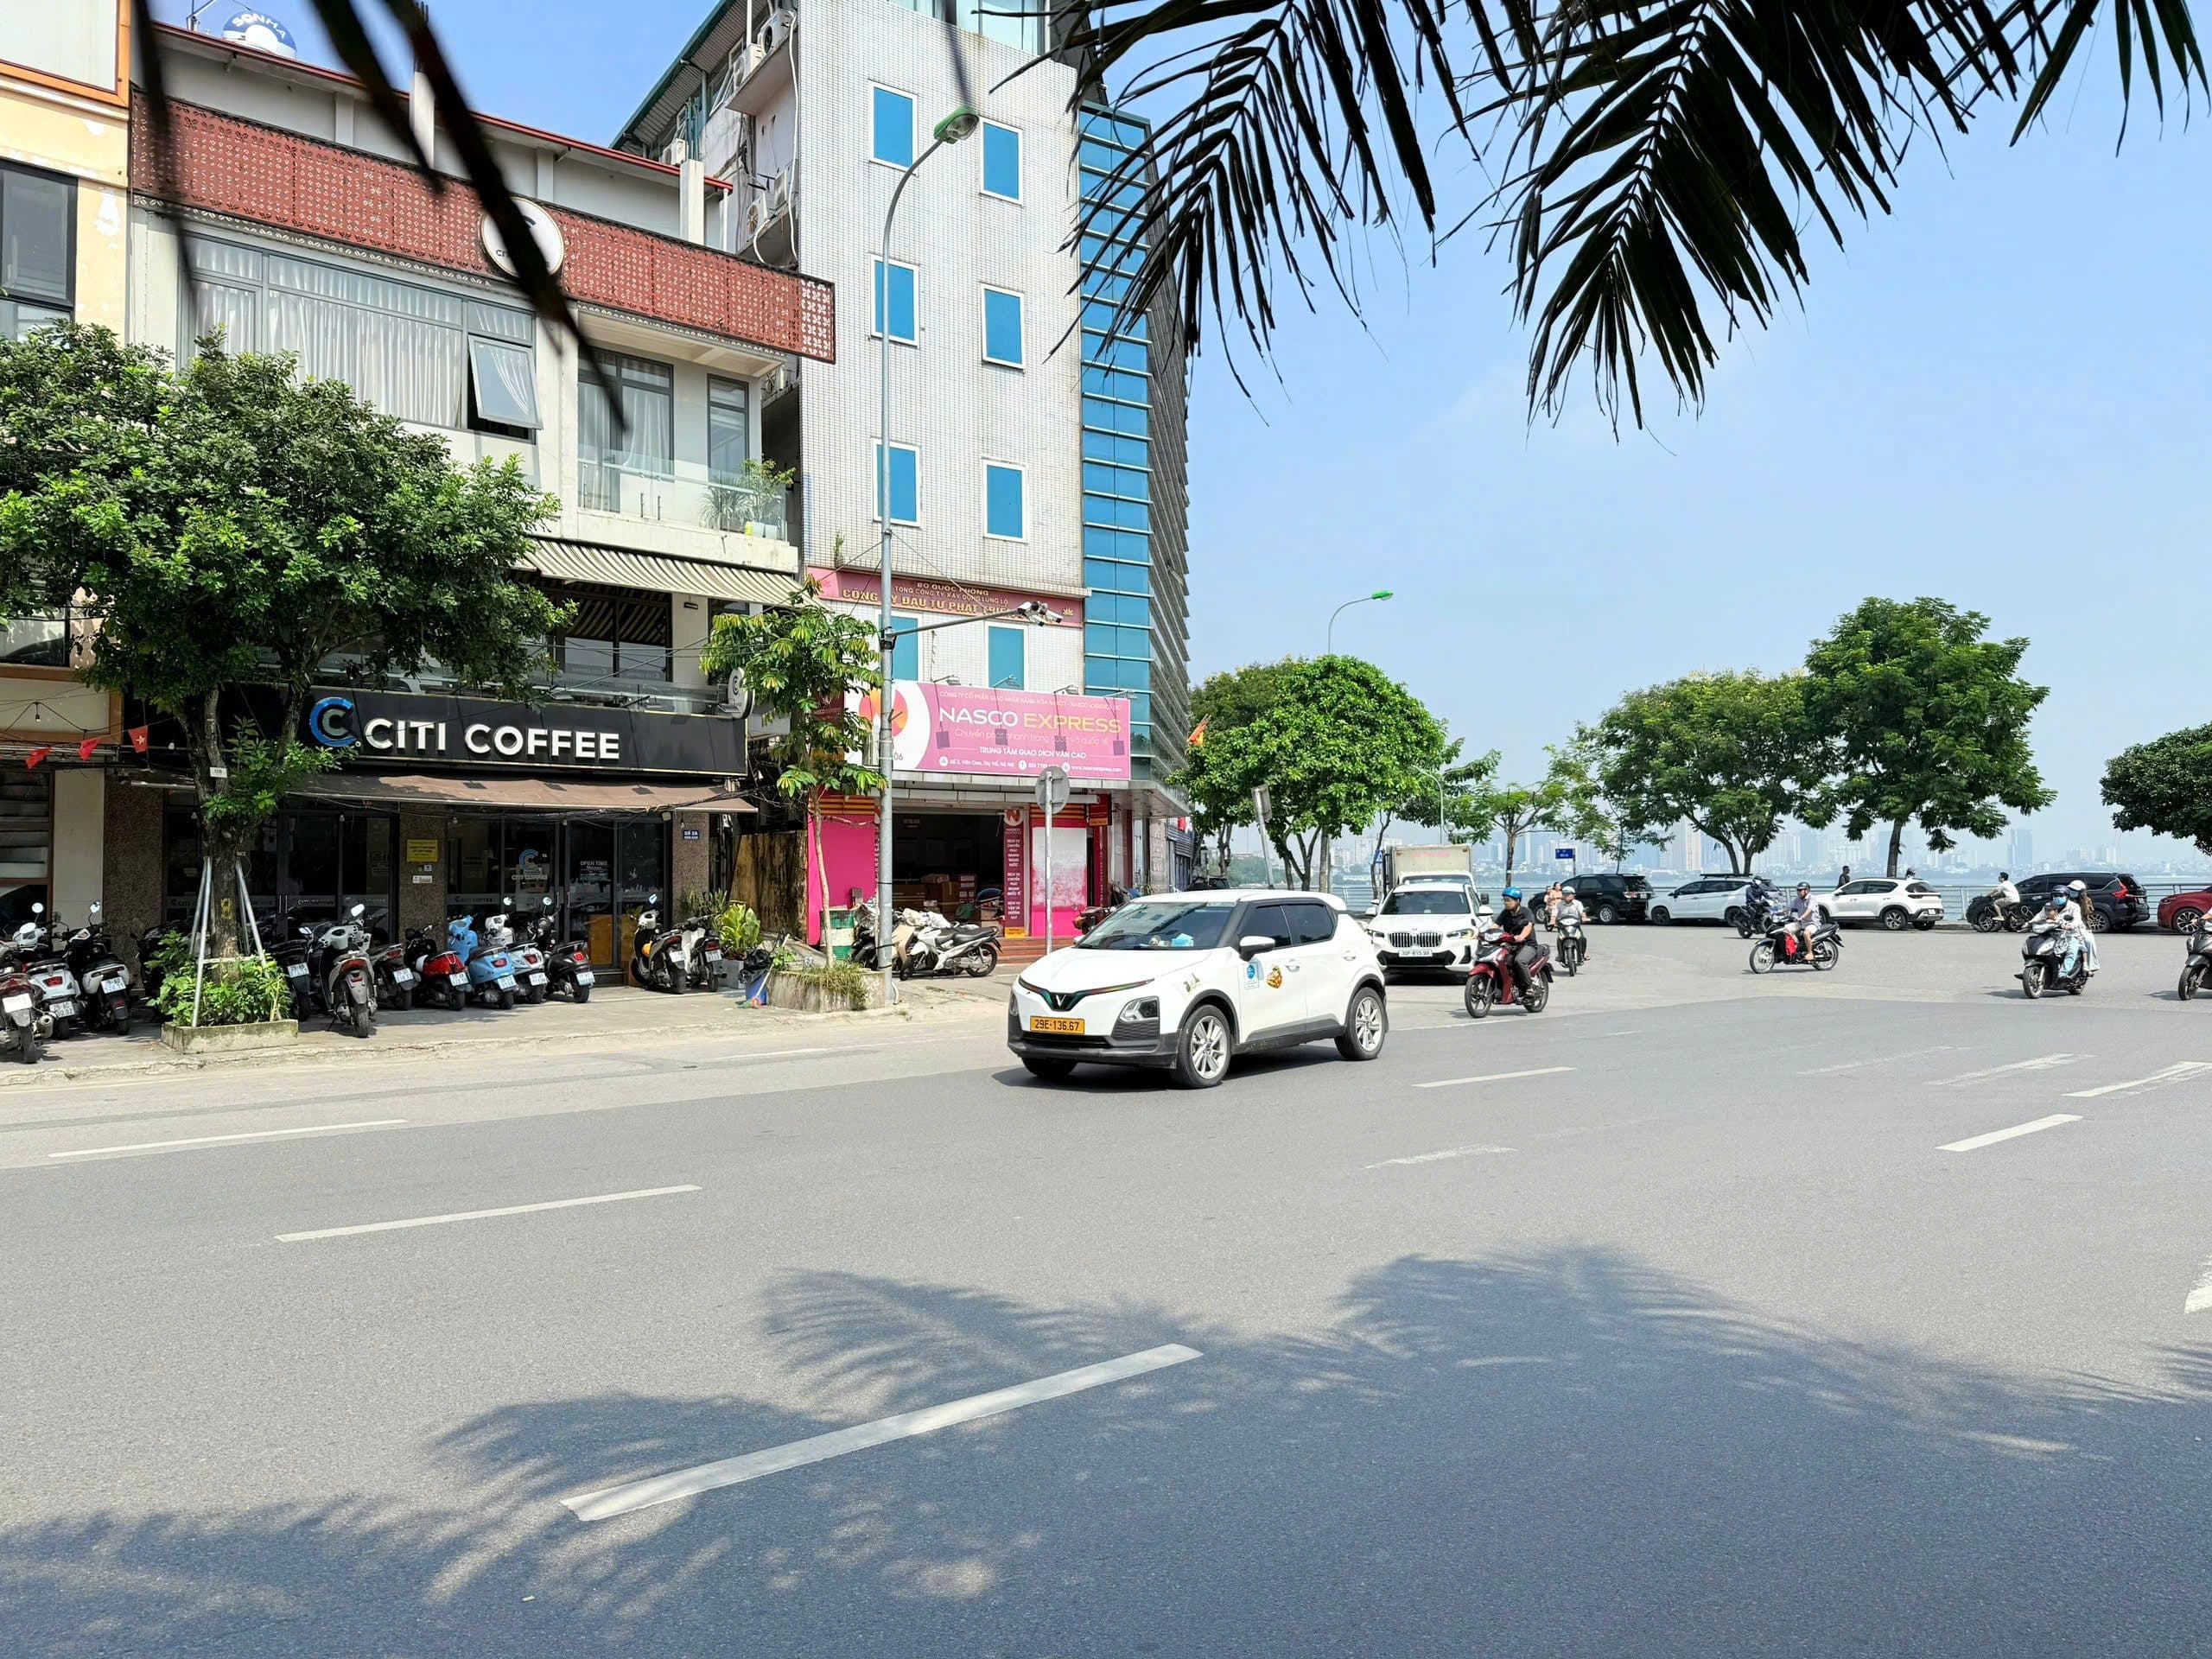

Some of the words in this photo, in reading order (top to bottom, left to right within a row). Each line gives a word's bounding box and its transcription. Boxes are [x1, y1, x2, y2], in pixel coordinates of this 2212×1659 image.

[842, 588, 879, 601] CÔNG
[939, 707, 1018, 727] NASCO
[1023, 713, 1122, 734] EXPRESS
[364, 718, 447, 752] CITI
[464, 723, 620, 760] COFFEE
[979, 746, 1002, 754] TRUNG
[1002, 746, 1018, 755] TÂM
[1038, 748, 1054, 758] DỊCH
